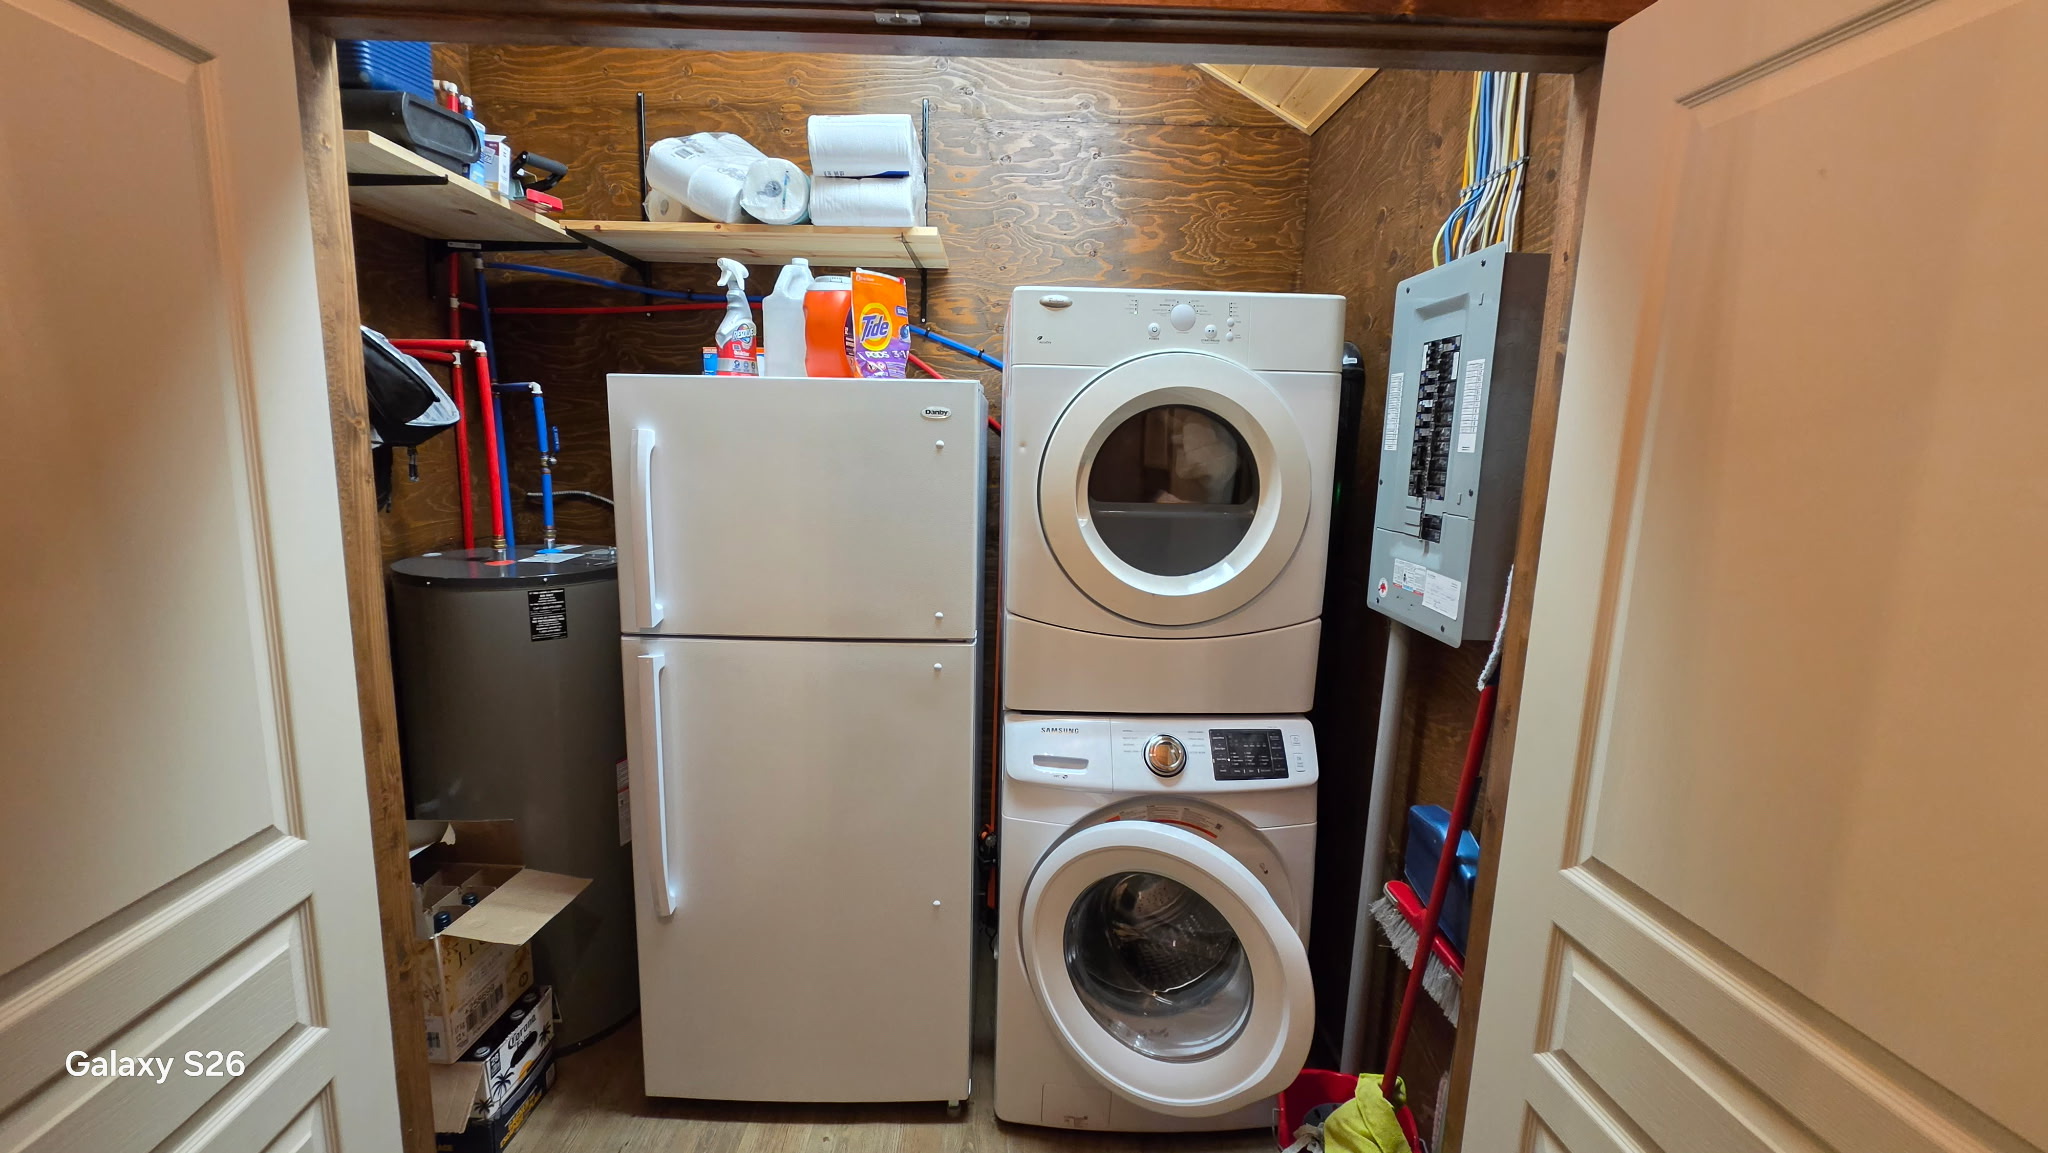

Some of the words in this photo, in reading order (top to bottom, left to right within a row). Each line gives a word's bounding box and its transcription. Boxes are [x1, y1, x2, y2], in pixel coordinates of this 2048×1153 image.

[861, 312, 889, 343] Tide
[865, 350, 890, 359] PODS
[925, 409, 949, 417] Danby
[1041, 727, 1080, 735] SAMSUNG
[507, 1013, 537, 1050] Corona
